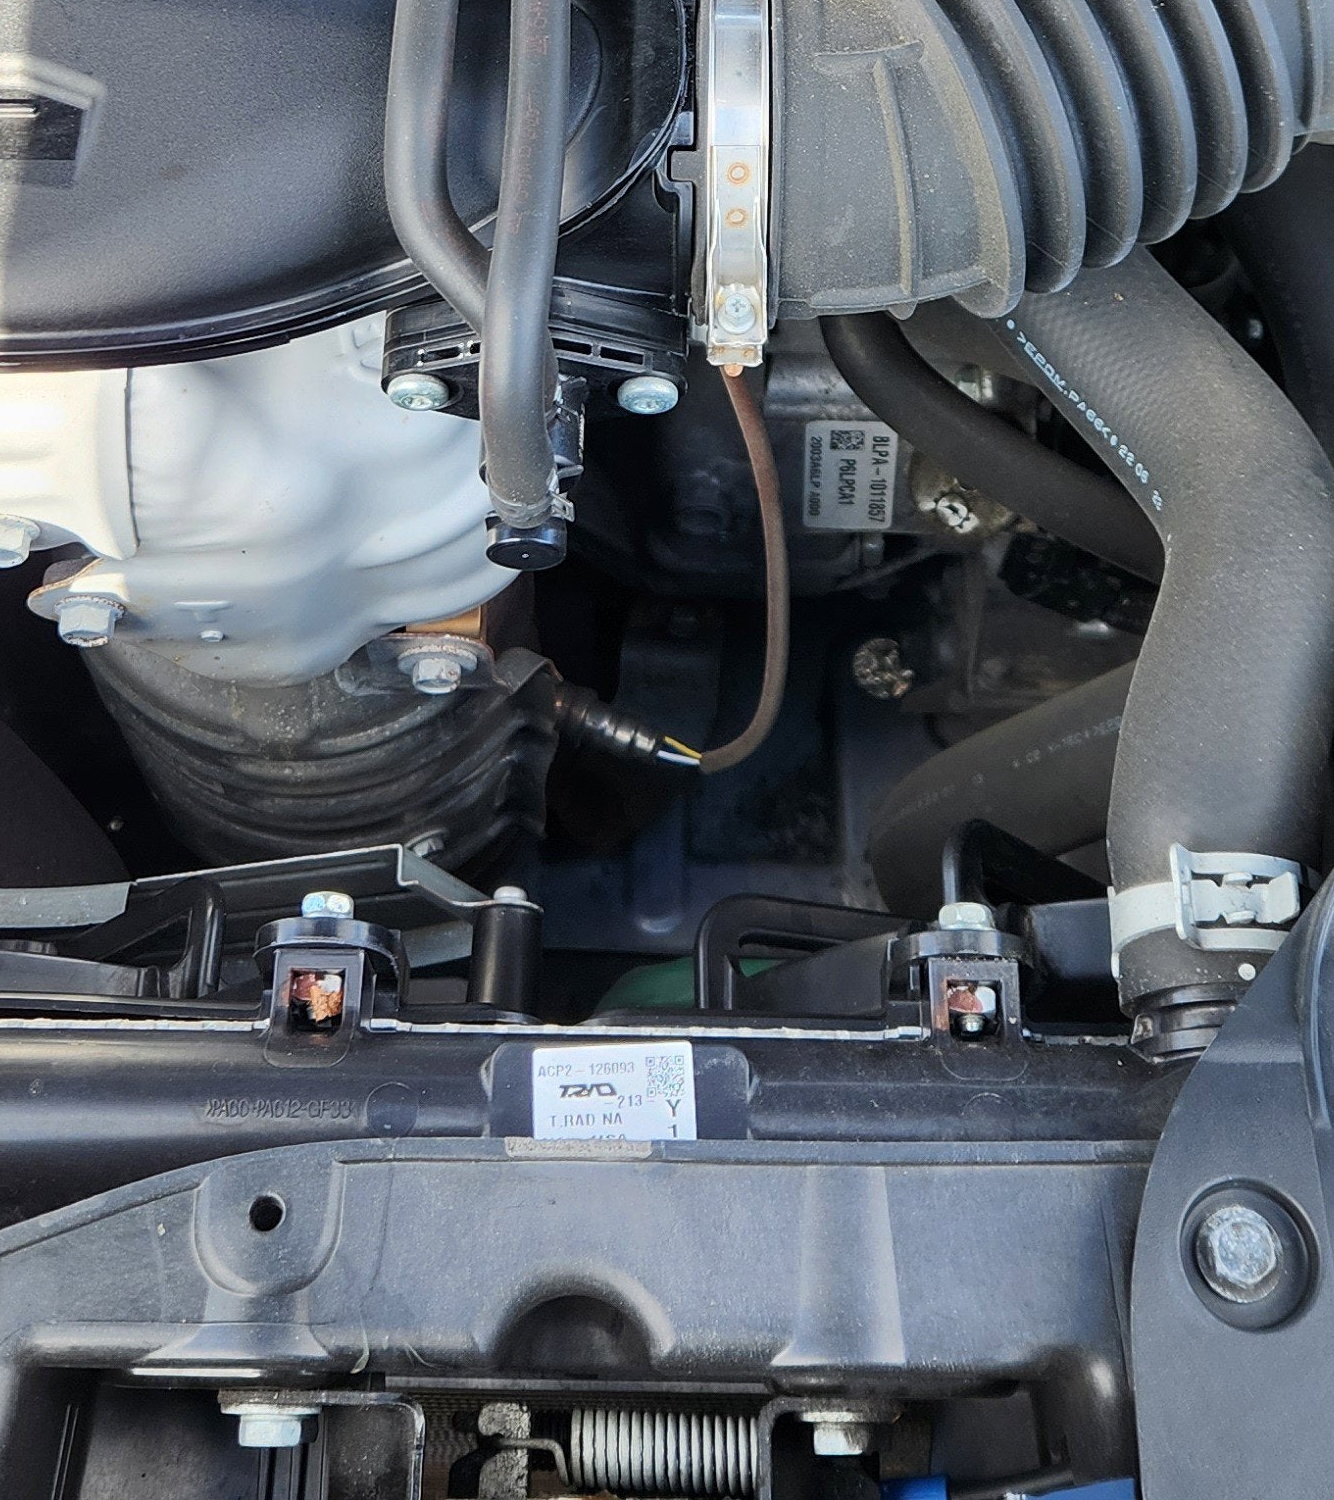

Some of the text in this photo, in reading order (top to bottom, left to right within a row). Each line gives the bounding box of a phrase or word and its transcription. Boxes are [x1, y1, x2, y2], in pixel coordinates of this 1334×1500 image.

[838, 458, 857, 506] P6LPCA1
[667, 1099, 681, 1118] Y
[550, 1112, 623, 1128] T.RAD NA
